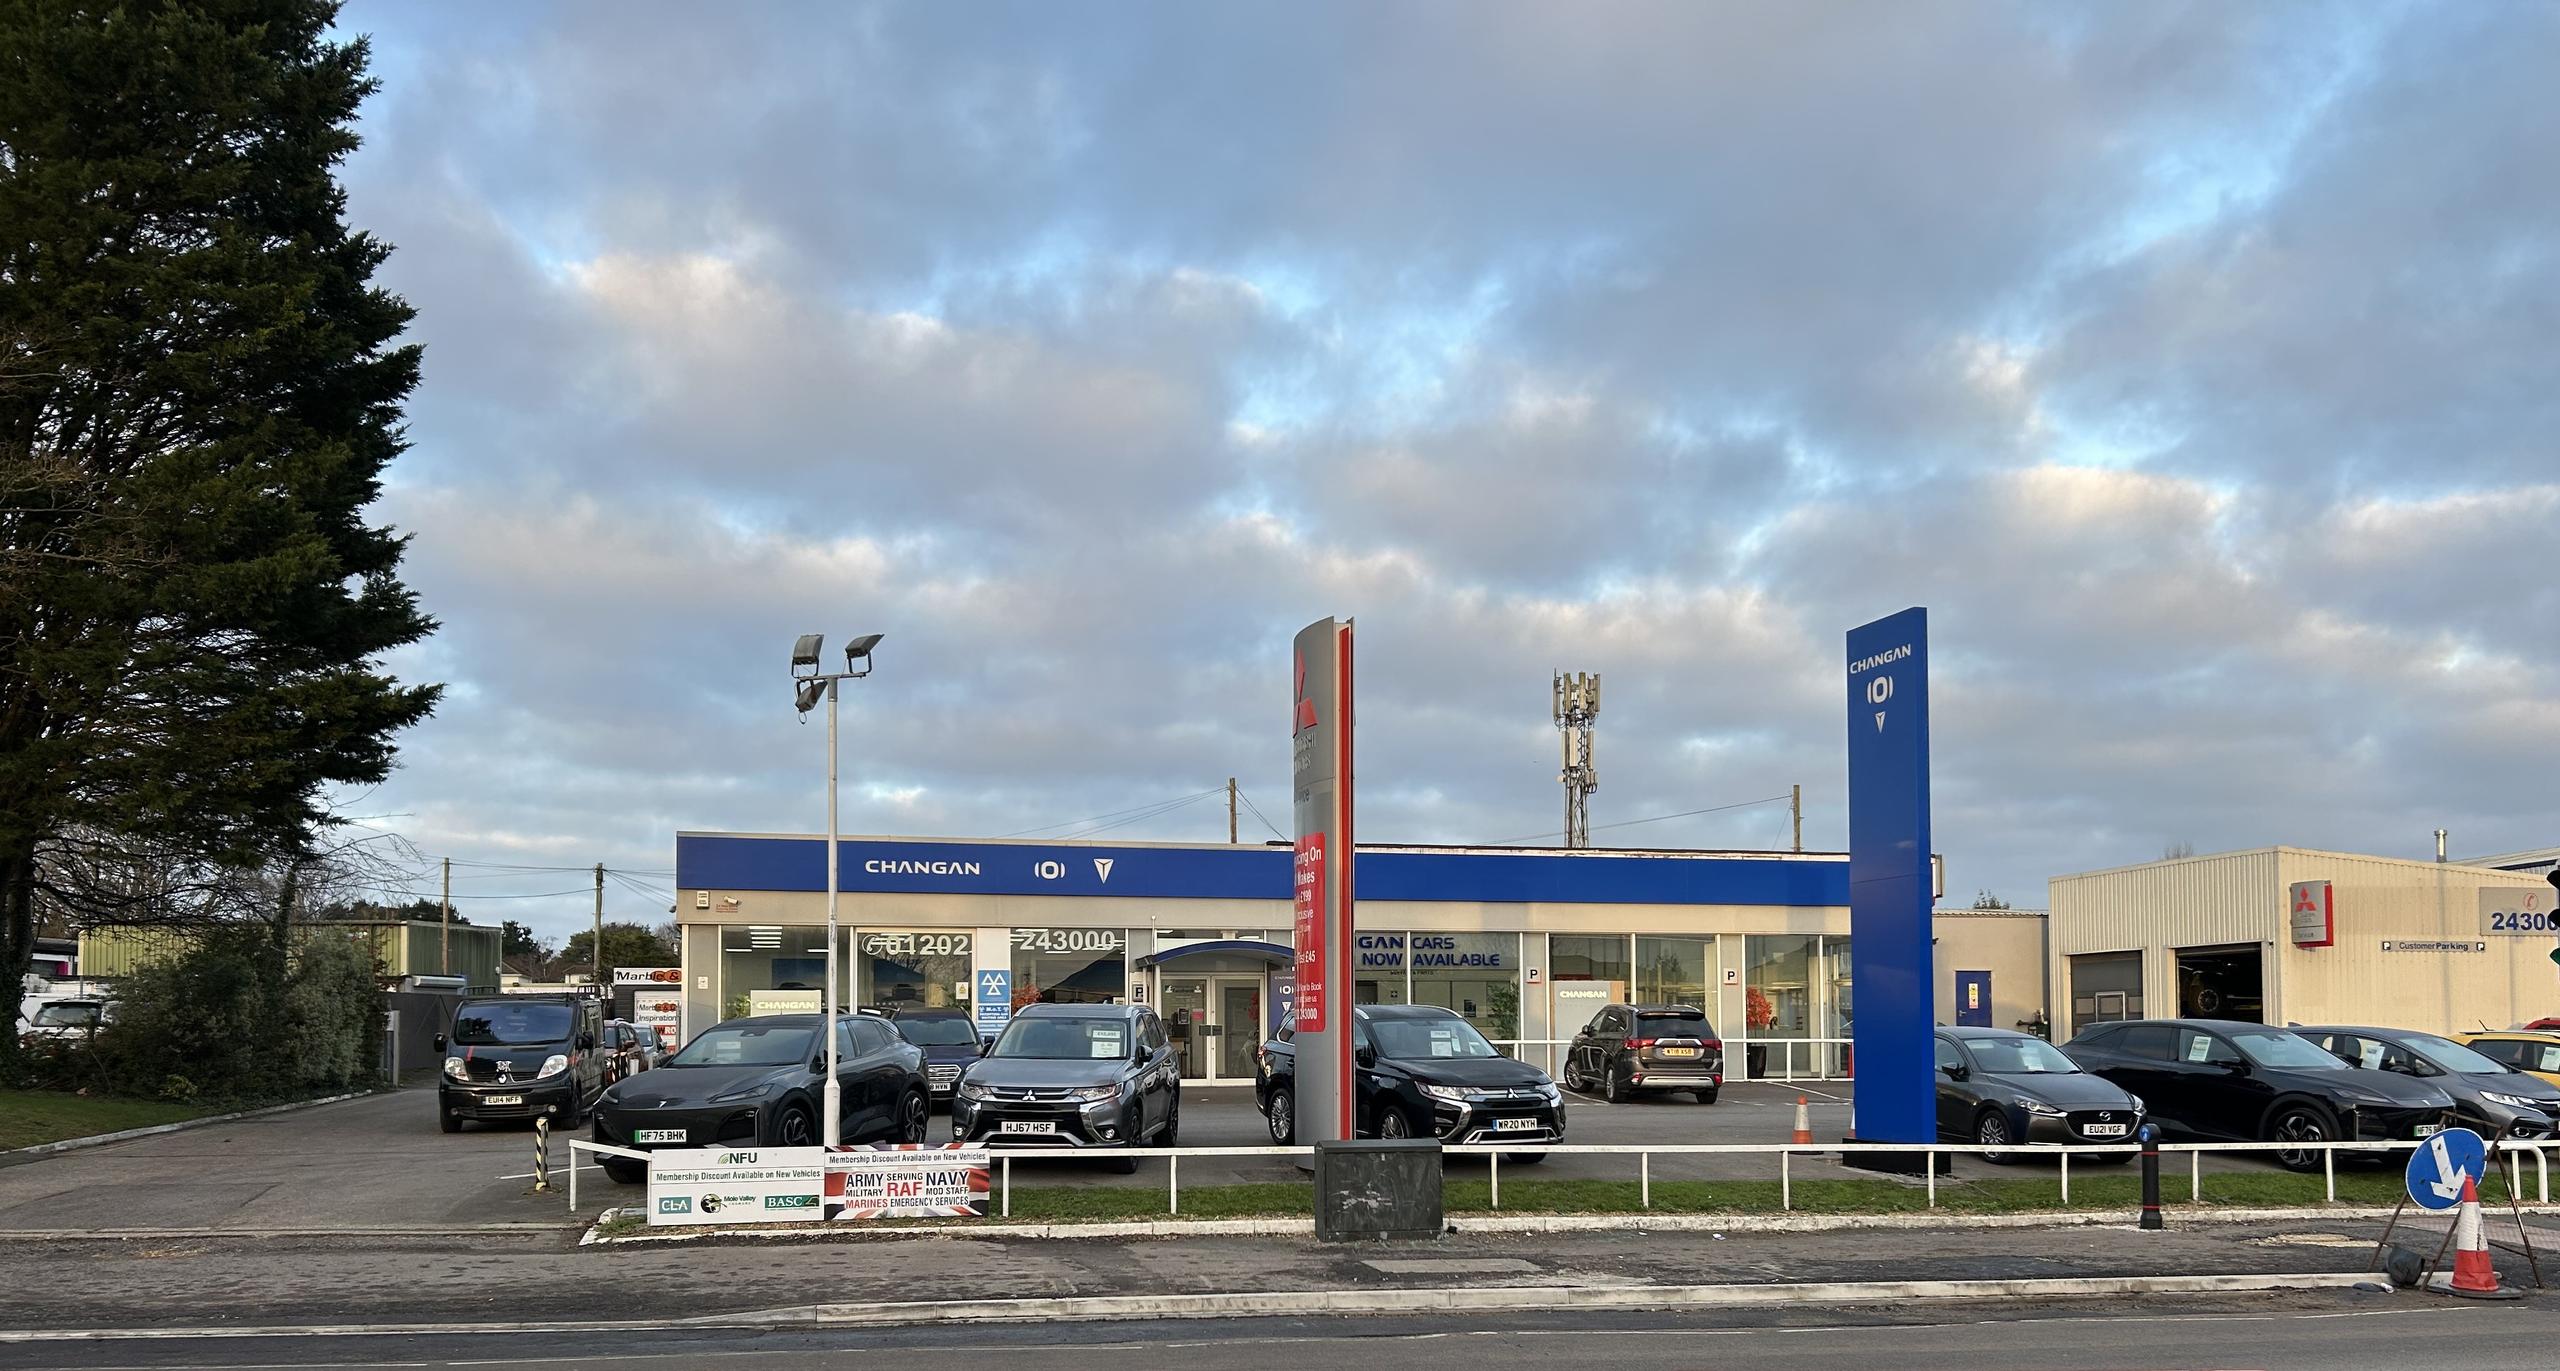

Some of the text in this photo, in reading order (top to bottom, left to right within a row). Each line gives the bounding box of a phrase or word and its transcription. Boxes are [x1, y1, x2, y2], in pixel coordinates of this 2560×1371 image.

[1850, 643, 1911, 674] CHANGAN
[1310, 846, 1322, 862] On
[865, 860, 981, 875] CHANGAN
[885, 930, 1116, 956] 01202 243000
[1358, 936, 1455, 950] GAN CARS
[2436, 943, 2469, 951] Parking
[1305, 950, 1316, 963] £45
[1362, 953, 1500, 967] NOW AVAILABLE
[669, 971, 679, 980] &
[1530, 969, 1538, 979] P
[1727, 970, 1735, 981] P
[1136, 987, 1144, 998] P
[1559, 990, 1607, 999] CHANGAN
[757, 1001, 815, 1009] CHANGAN
[1006, 1123, 1052, 1133] HJ67 HSF
[2089, 1125, 2107, 1134] EU21
[640, 1131, 685, 1141] HF75 BHK
[729, 1152, 758, 1164] NFU
[829, 1155, 870, 1164] Membership
[872, 1154, 900, 1163] Discount
[902, 1152, 932, 1162] Available
[943, 1152, 958, 1161] New
[959, 1151, 986, 1160] Vehicles
[656, 1172, 700, 1182] Membership
[701, 1172, 731, 1180] Discount
[733, 1170, 764, 1179] Available
[776, 1170, 791, 1178] New
[792, 1169, 821, 1178] Vehicles
[846, 1171, 969, 1188] ARMY SERVING NAVY
[845, 1182, 969, 1198] MILITARY RAF MOD STAFF
[661, 1200, 688, 1212] CLA
[768, 1196, 803, 1207] BASC
[845, 1196, 969, 1209] MARINES EMERGENCY SERVICES
